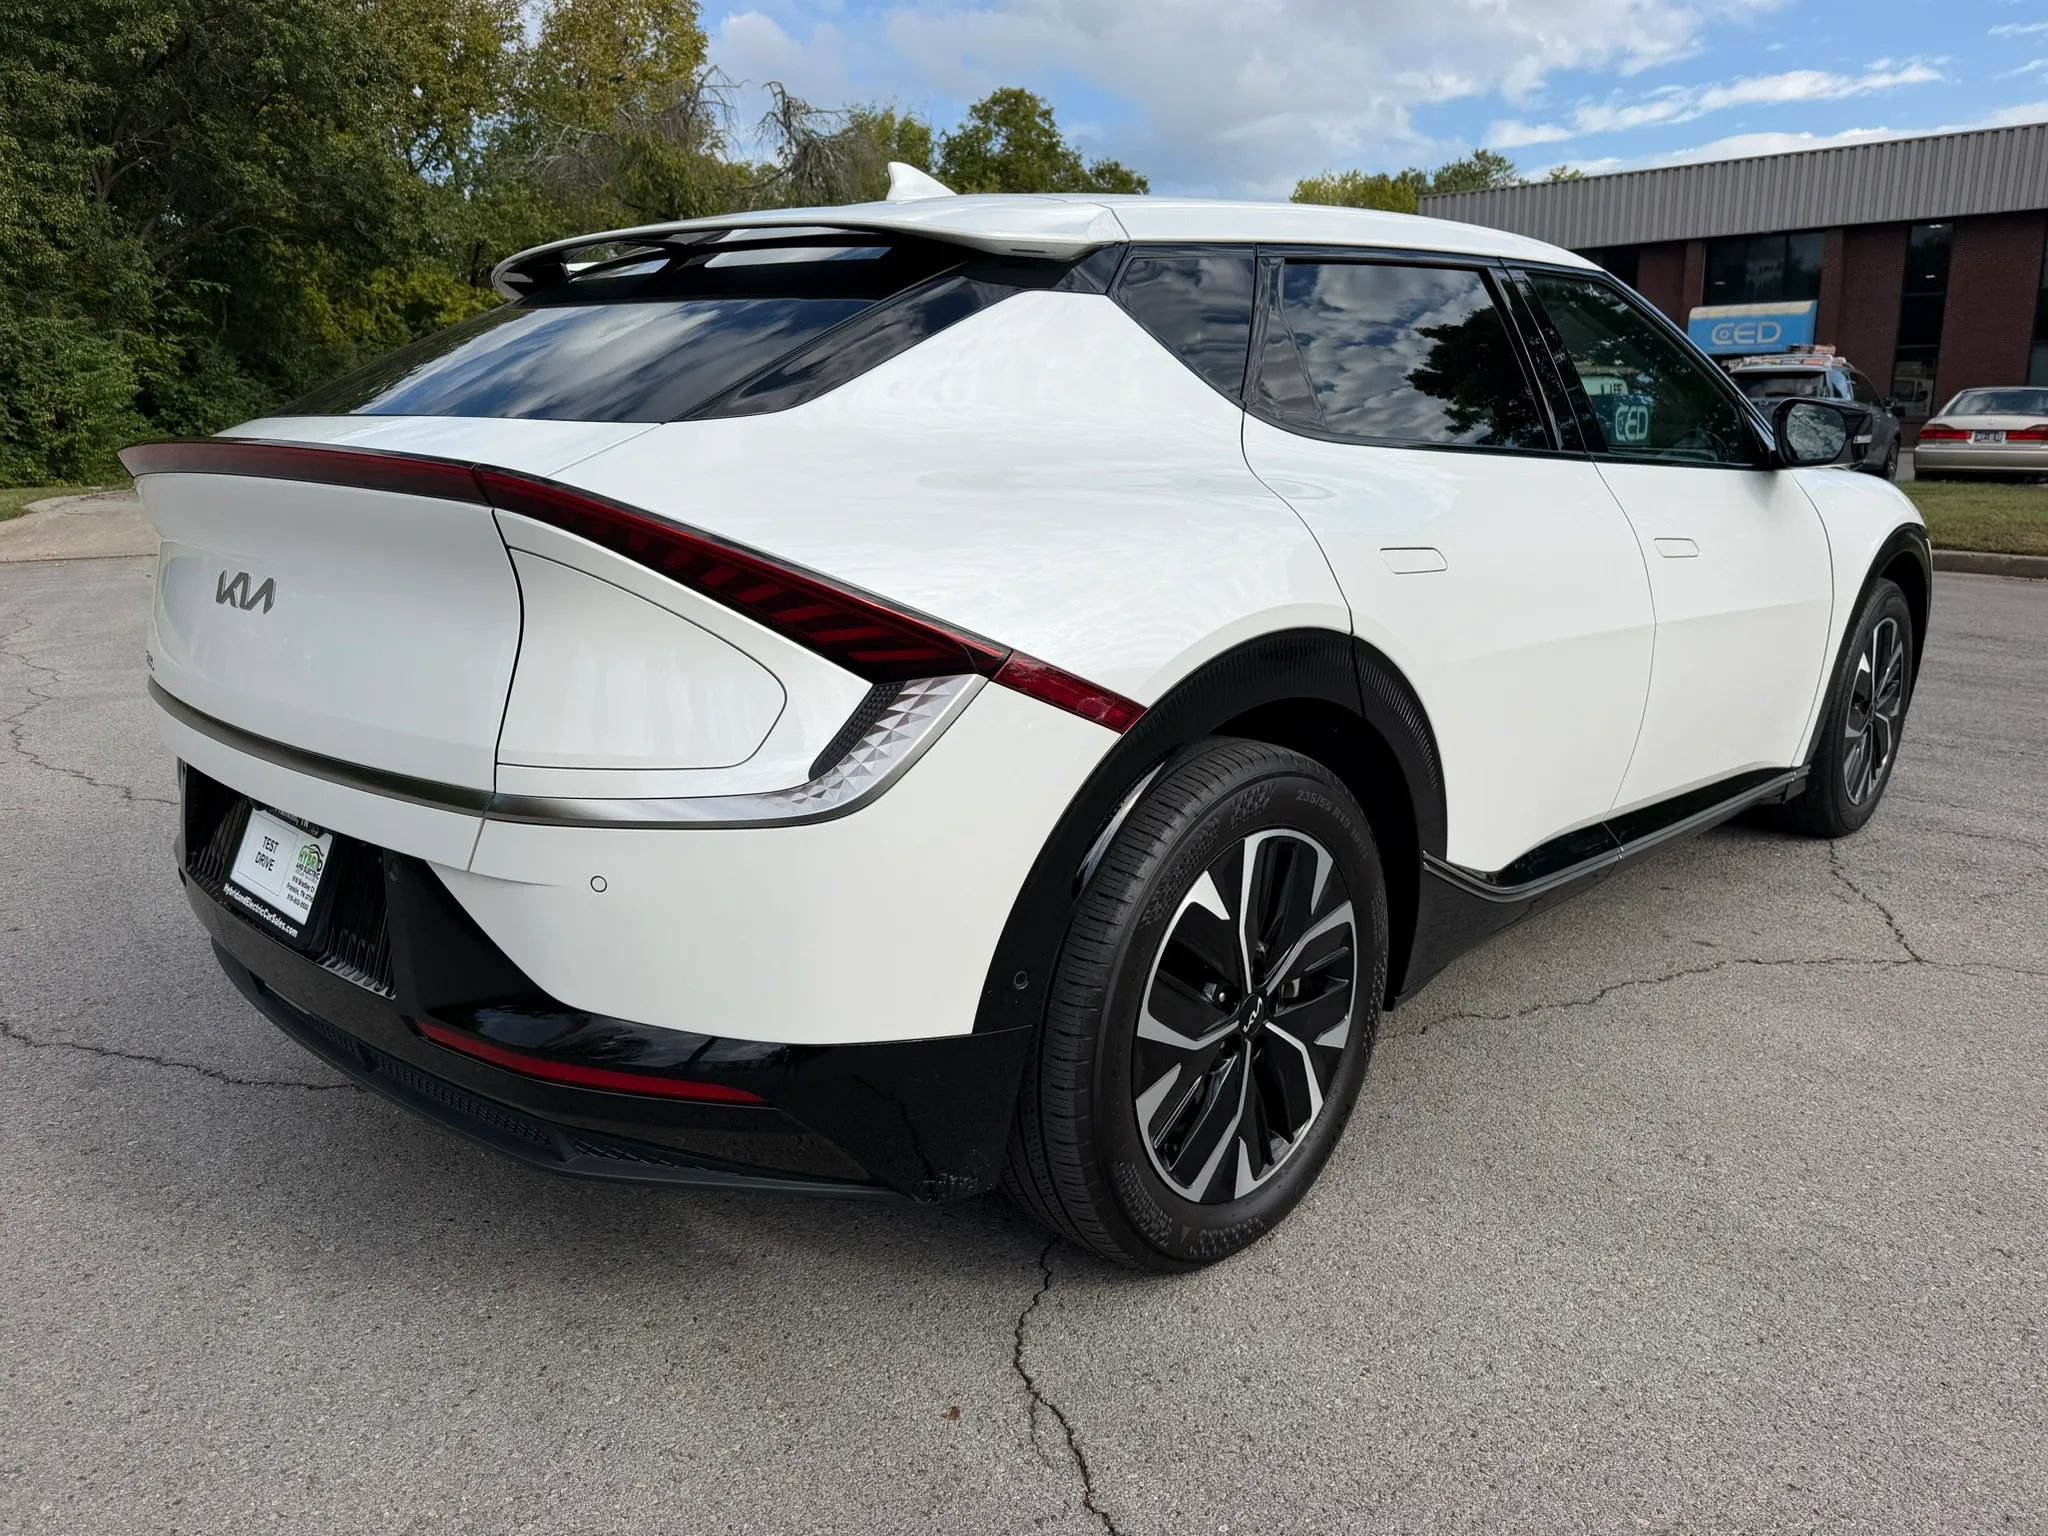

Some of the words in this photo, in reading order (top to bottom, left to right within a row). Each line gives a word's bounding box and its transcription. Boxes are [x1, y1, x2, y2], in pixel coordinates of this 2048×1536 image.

[1711, 321, 1781, 345] CED
[1615, 404, 1649, 441] CED
[215, 570, 276, 615] KIA
[1296, 789, 1333, 812] 235/55
[263, 835, 279, 854] TEST
[255, 851, 275, 871] DRIVE
[222, 882, 299, 938] HybridandElectricCarSales.com
[1242, 996, 1263, 1033] KIA
